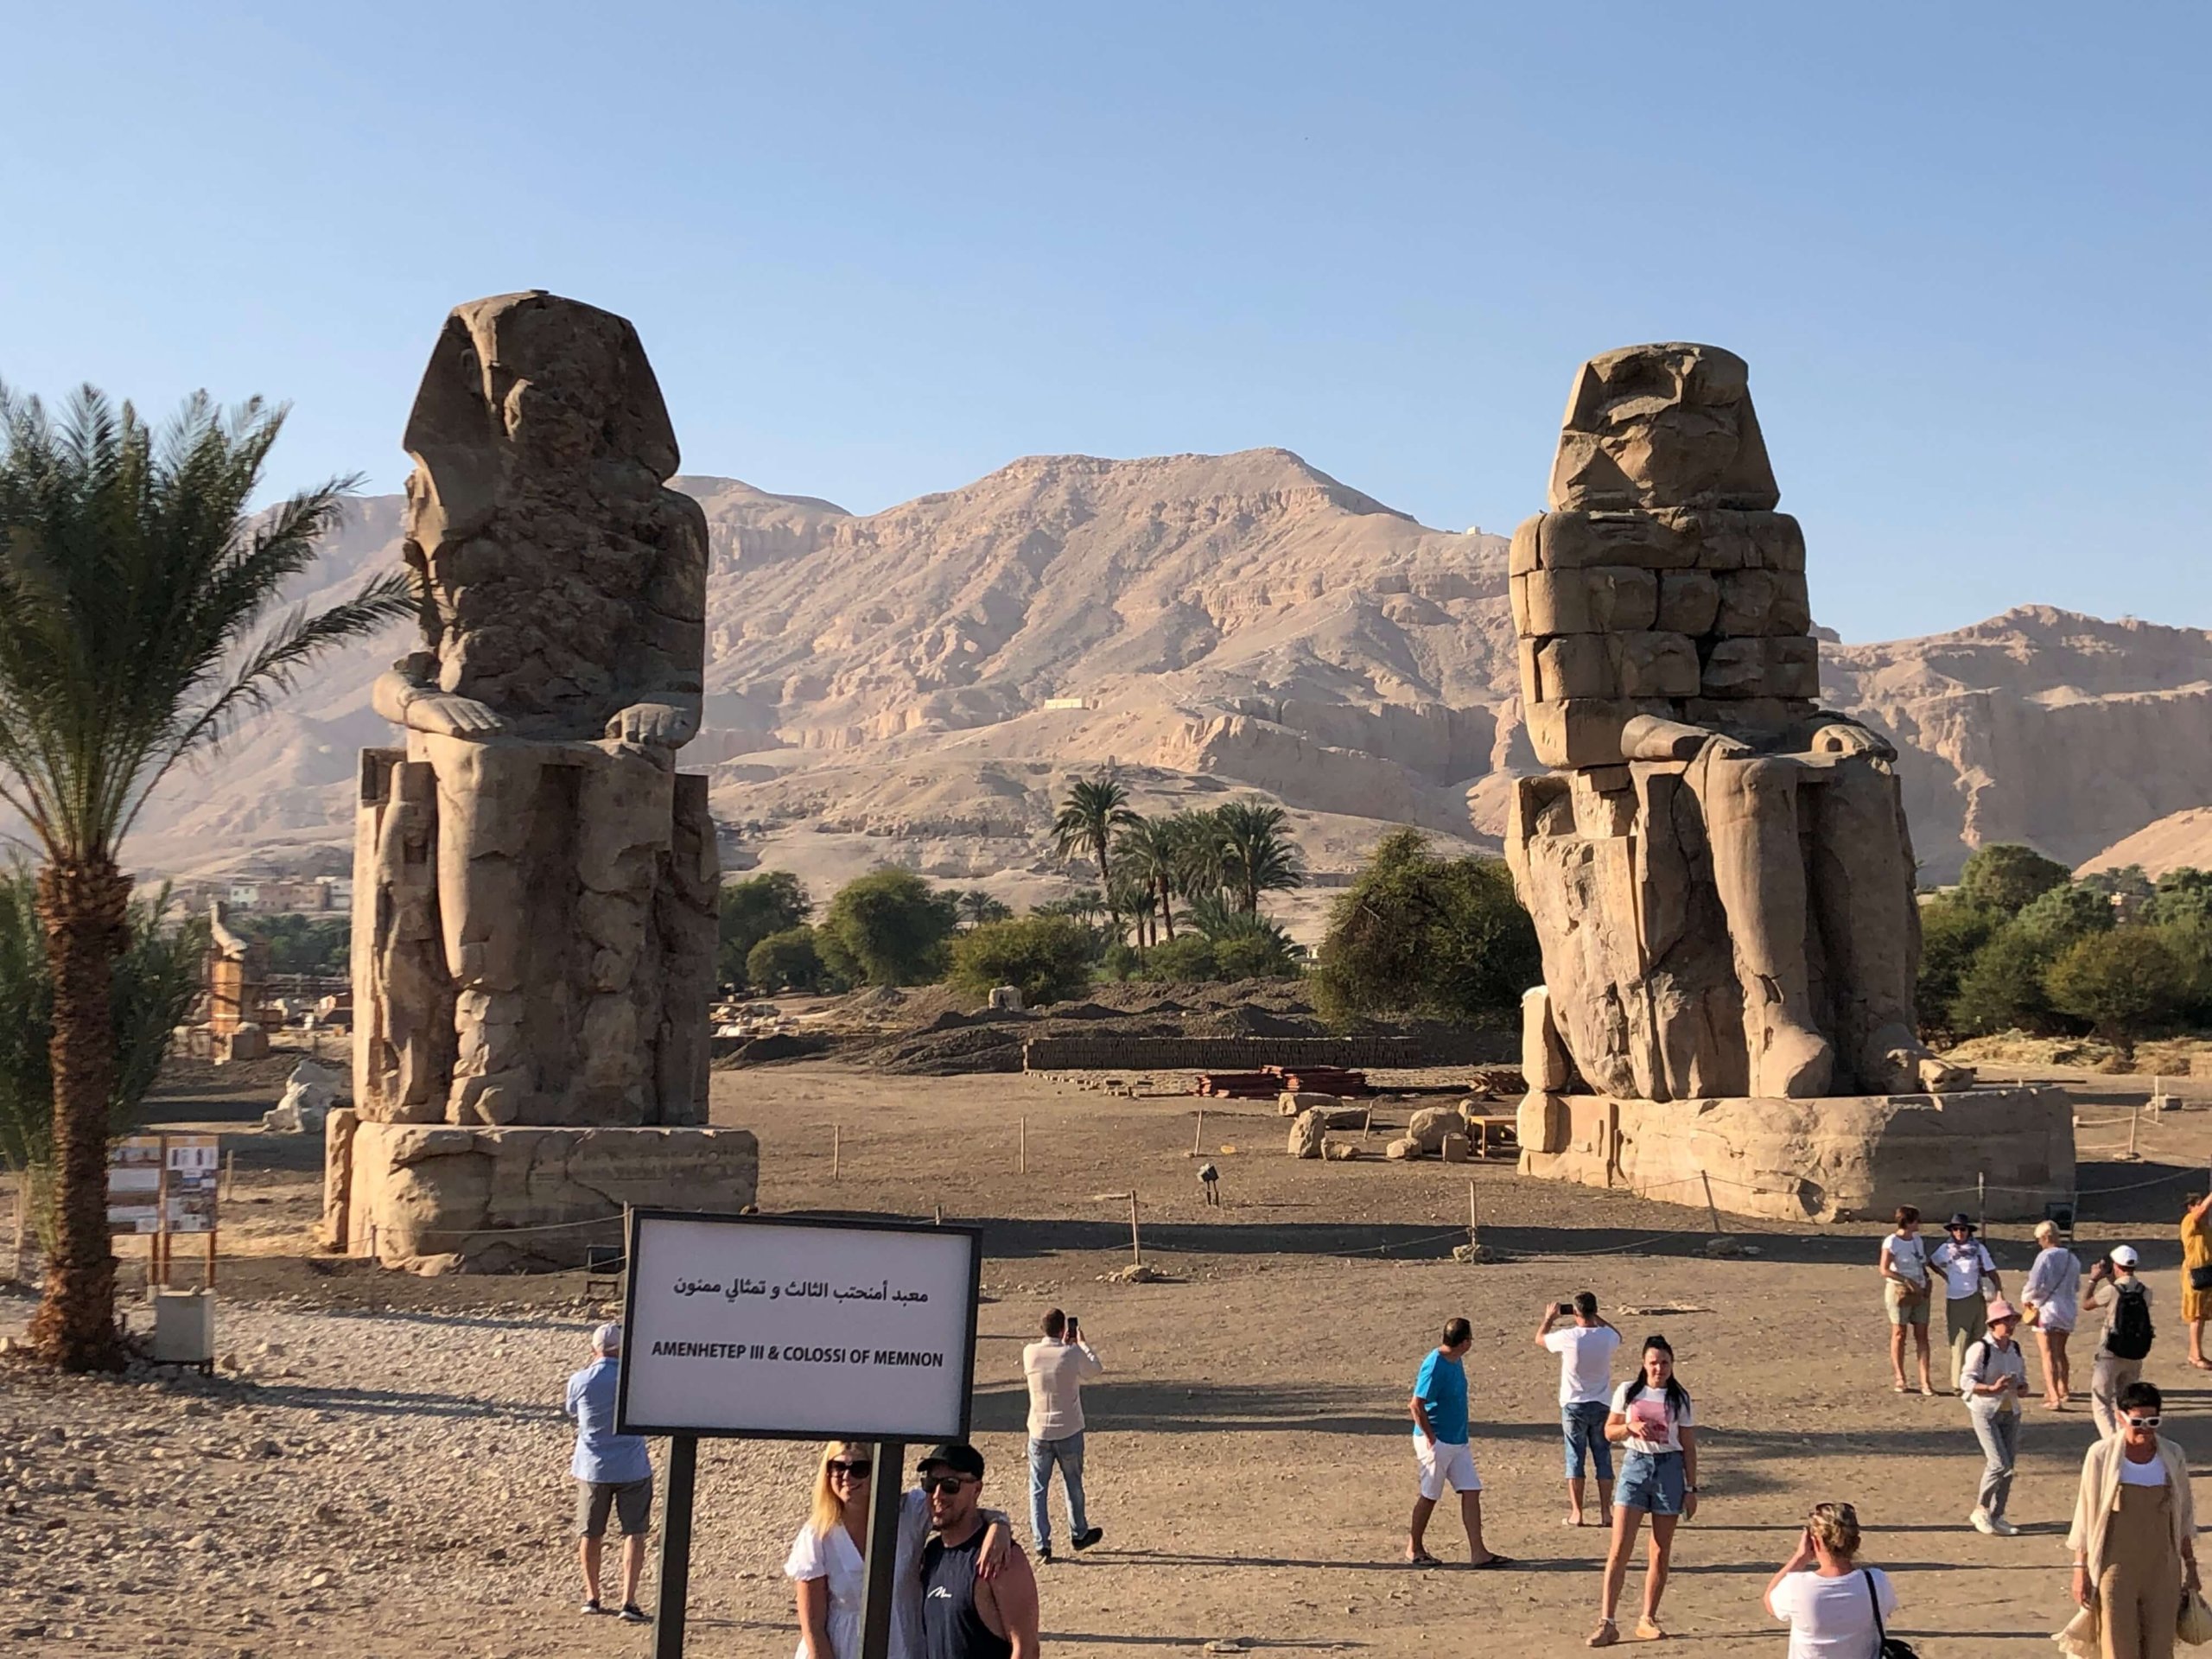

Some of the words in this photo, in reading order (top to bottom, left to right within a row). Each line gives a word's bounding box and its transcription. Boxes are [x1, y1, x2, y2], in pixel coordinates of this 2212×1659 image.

[673, 1277, 721, 1296] ممنون
[769, 1285, 780, 1300] و
[785, 1281, 829, 1298] الثالث
[832, 1280, 888, 1304] أمنحتب
[891, 1290, 929, 1307] معبد
[651, 1341, 747, 1359] AMENHETEP
[749, 1344, 765, 1360] III
[767, 1345, 779, 1360] &
[783, 1346, 846, 1363] COLOSSI
[849, 1349, 870, 1364] OF
[873, 1350, 944, 1367] MEMNON
